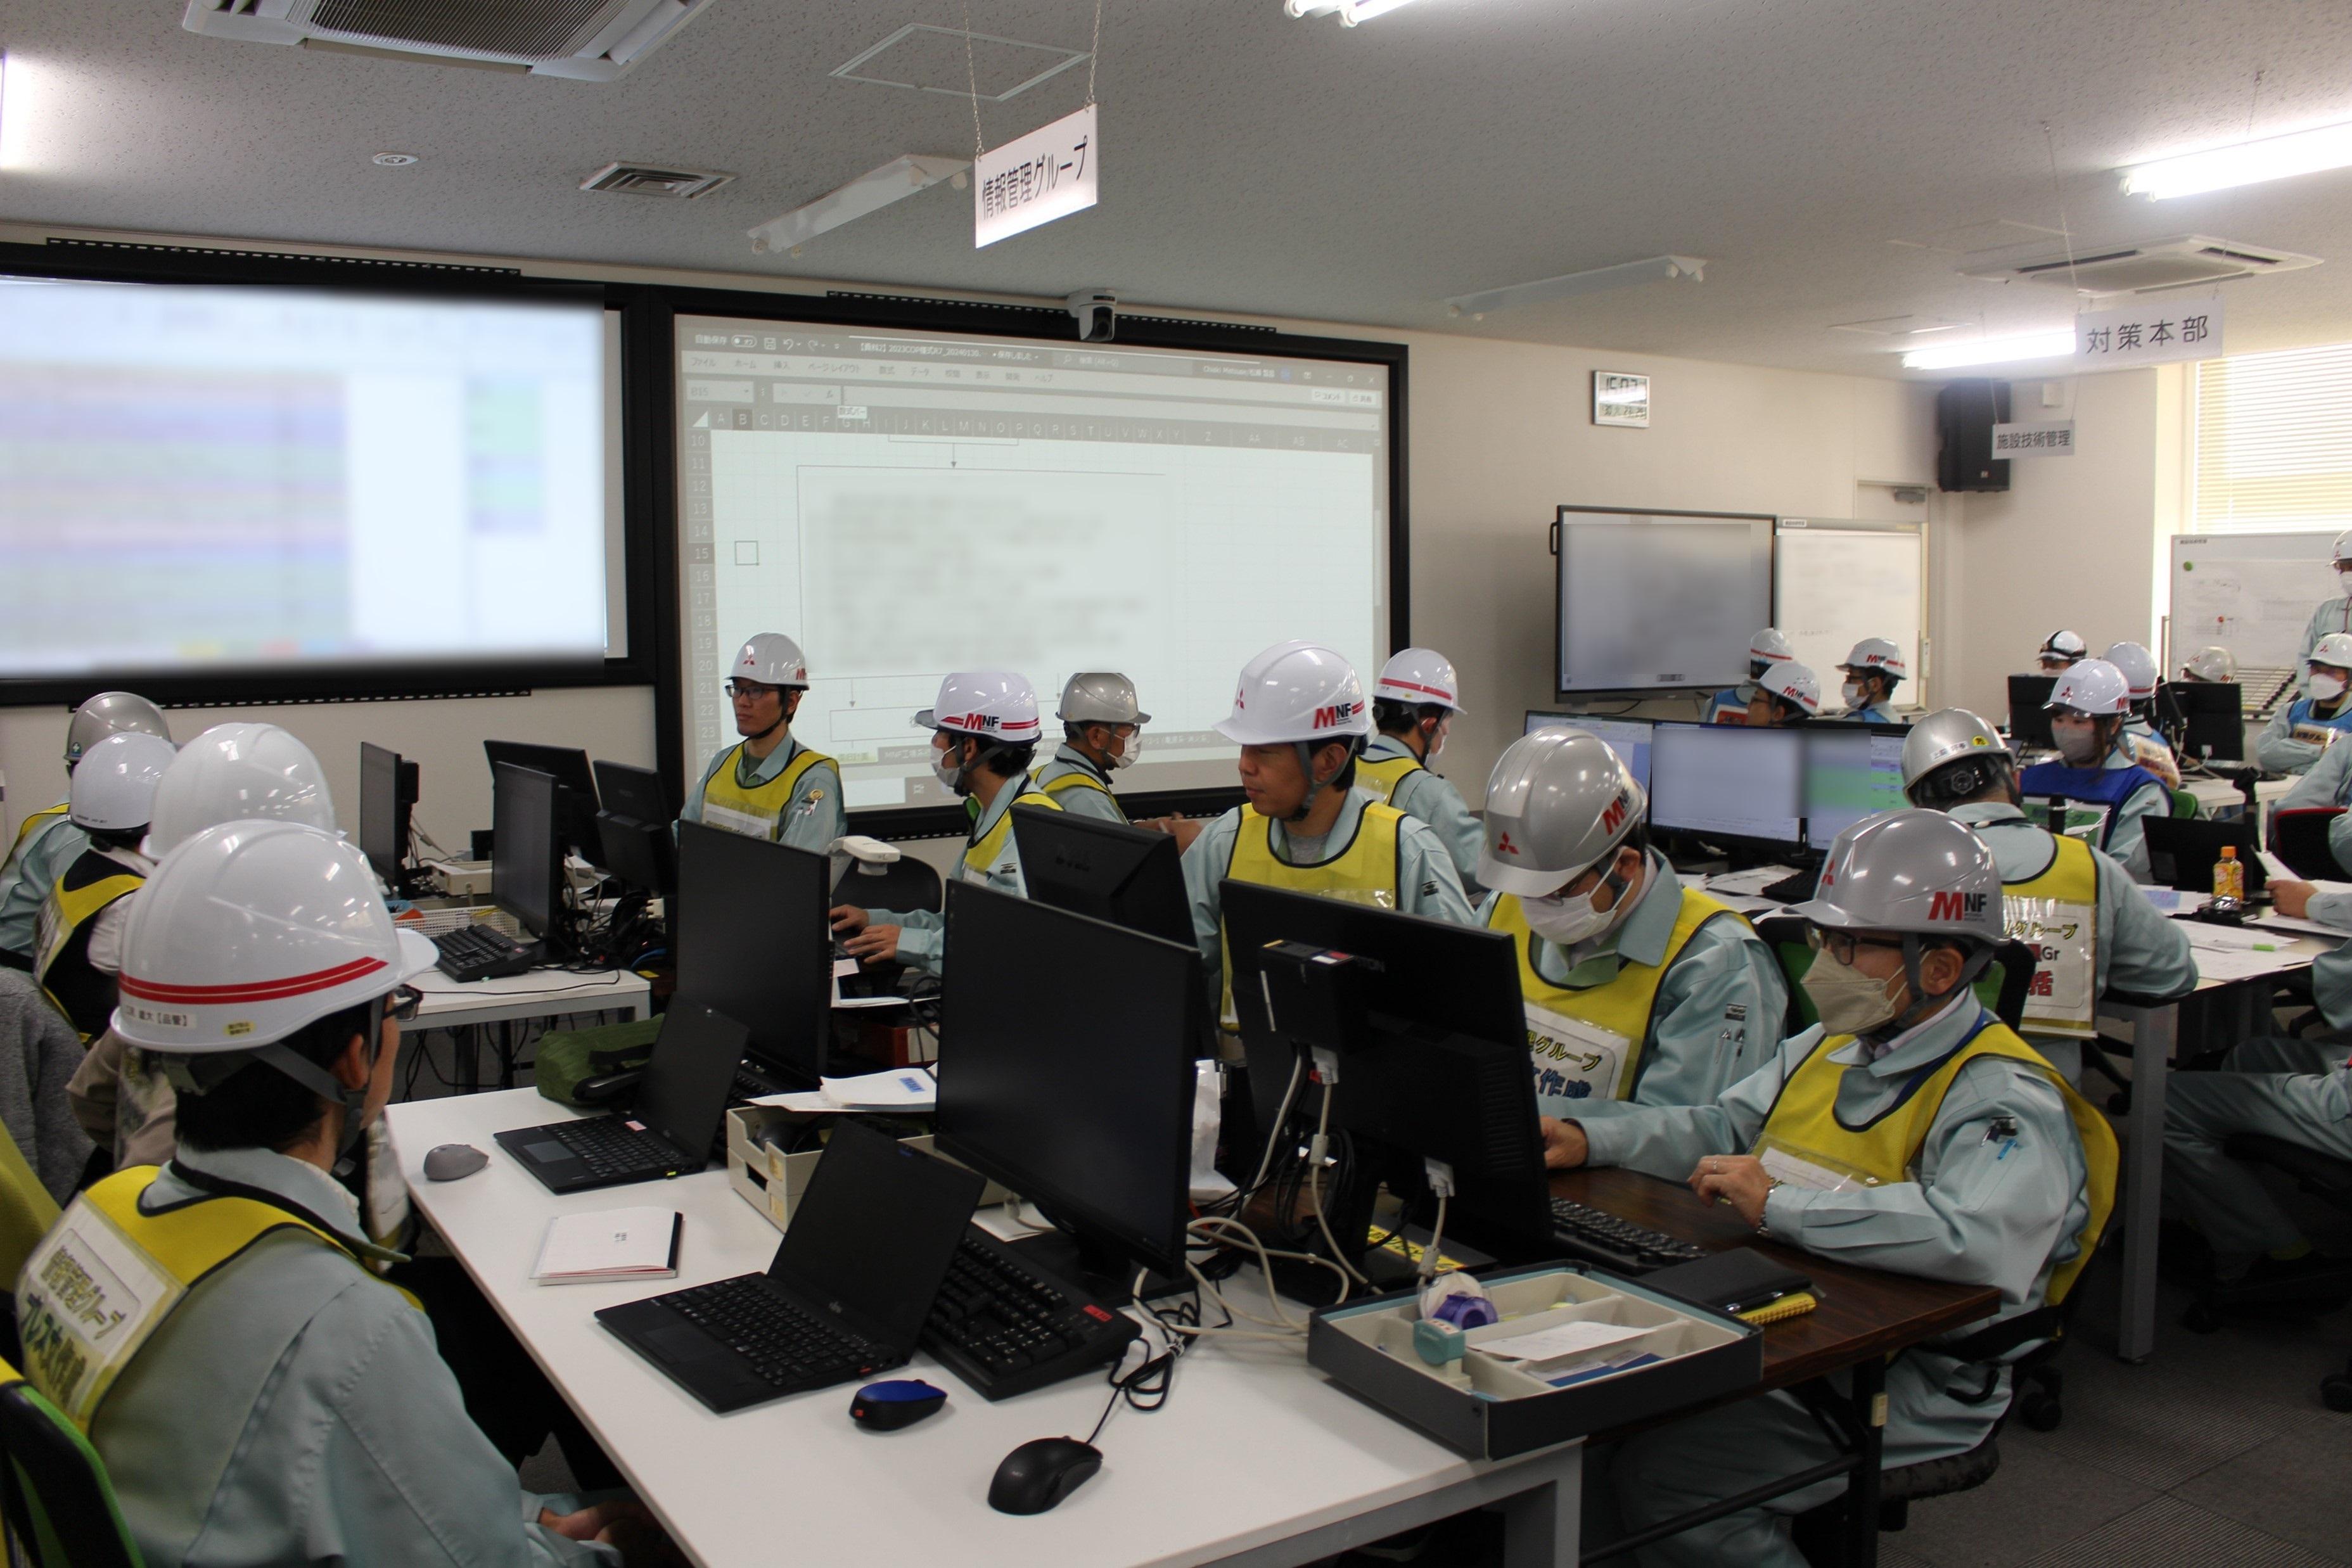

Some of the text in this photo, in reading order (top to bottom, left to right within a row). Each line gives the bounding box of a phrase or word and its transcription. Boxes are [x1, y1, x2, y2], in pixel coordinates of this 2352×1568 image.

[982, 135, 1087, 220] 情報管理グループ
[2087, 314, 2209, 354] 対策本部
[717, 413, 725, 424] A
[739, 414, 747, 425] B
[760, 414, 769, 426] C
[781, 415, 789, 426] D
[802, 416, 809, 426] E
[822, 416, 829, 426] F
[842, 417, 850, 428] G
[862, 417, 871, 428] H
[922, 420, 930, 430] K
[942, 421, 949, 431] L
[959, 421, 969, 431] M
[997, 422, 1005, 433] O
[1016, 423, 1023, 433] P
[1033, 424, 1042, 435] Q
[1052, 425, 1059, 435] R
[1070, 426, 1077, 436] S
[1087, 426, 1094, 436] T
[1123, 427, 1130, 437] V
[1138, 428, 1147, 438] W
[1156, 429, 1163, 439] X
[1205, 431, 1211, 442] Z
[691, 435, 705, 447] 10
[1996, 429, 2071, 450] 施設技術管理
[693, 457, 705, 469] 11
[694, 480, 706, 492] 12
[694, 503, 707, 514] 13
[694, 525, 707, 537] 14
[695, 548, 709, 559] 15
[696, 570, 710, 582] 16
[697, 592, 710, 604] 17
[698, 615, 711, 627] 18
[698, 638, 712, 649] 19
[699, 660, 713, 672] 20
[700, 682, 713, 694] 21
[701, 704, 715, 716] 22
[1313, 703, 1352, 729] MNF
[964, 713, 999, 730] MNF
[701, 726, 716, 738] 23
[1928, 891, 1987, 921] MNF
[2004, 919, 2079, 940] グループ
[2042, 946, 2061, 961] Gr
[1532, 1067, 1592, 1099] 作成
